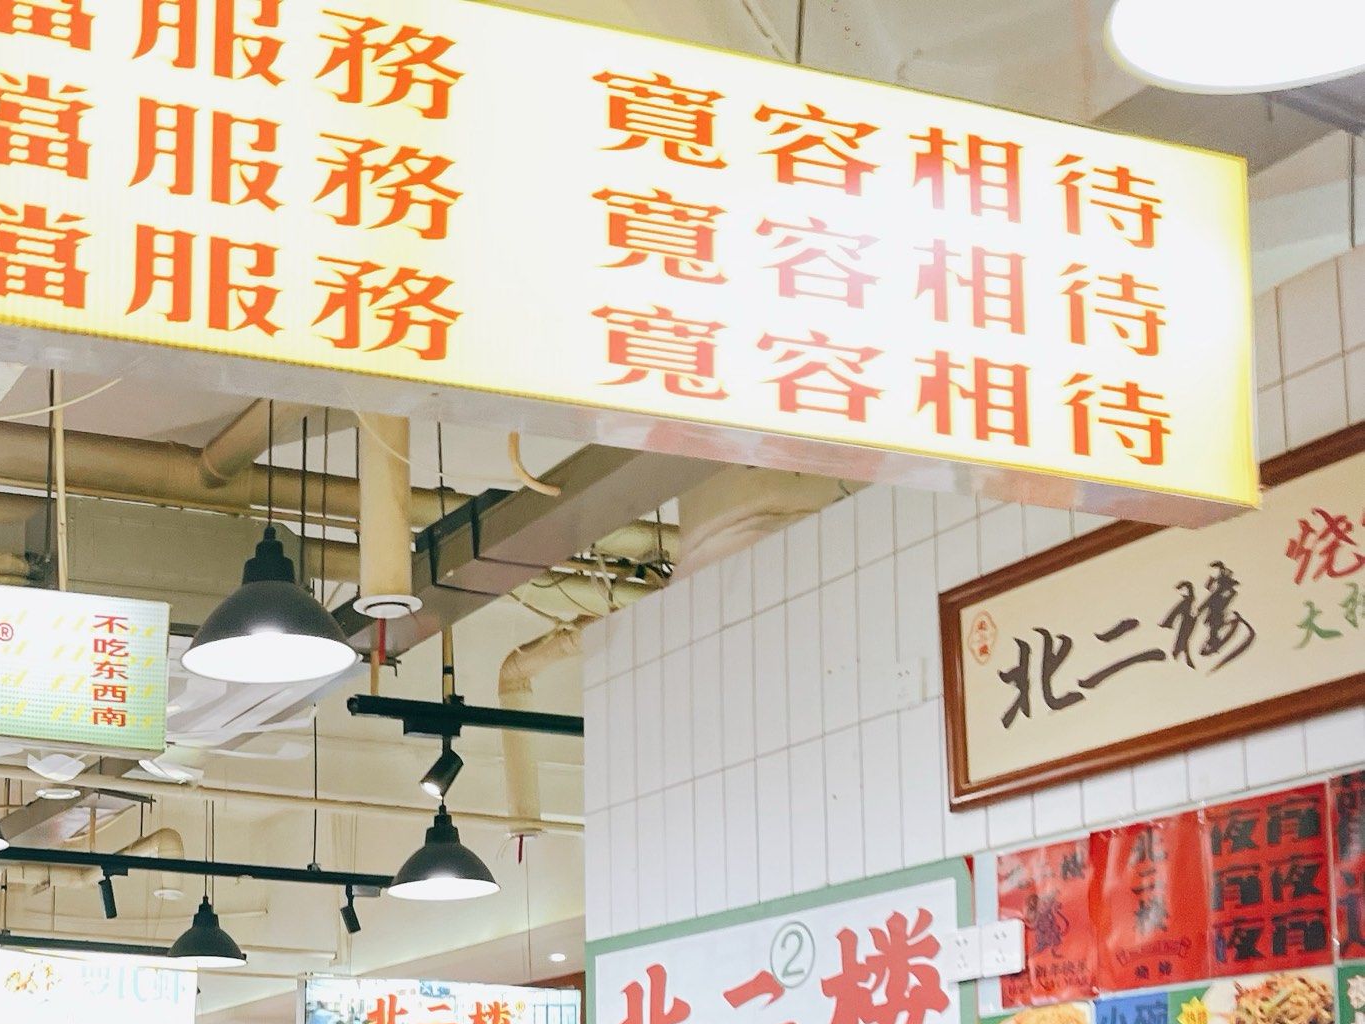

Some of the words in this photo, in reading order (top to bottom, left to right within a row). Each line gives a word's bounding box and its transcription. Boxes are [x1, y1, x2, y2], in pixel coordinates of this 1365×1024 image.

[591, 71, 1165, 250] 寬容相待
[591, 187, 1168, 358] 寬容相待
[591, 305, 1174, 467] 寬容相待
[1286, 506, 1365, 586] 烧
[92, 615, 129, 728] 不吃东西南
[997, 560, 1256, 729] 北二楼
